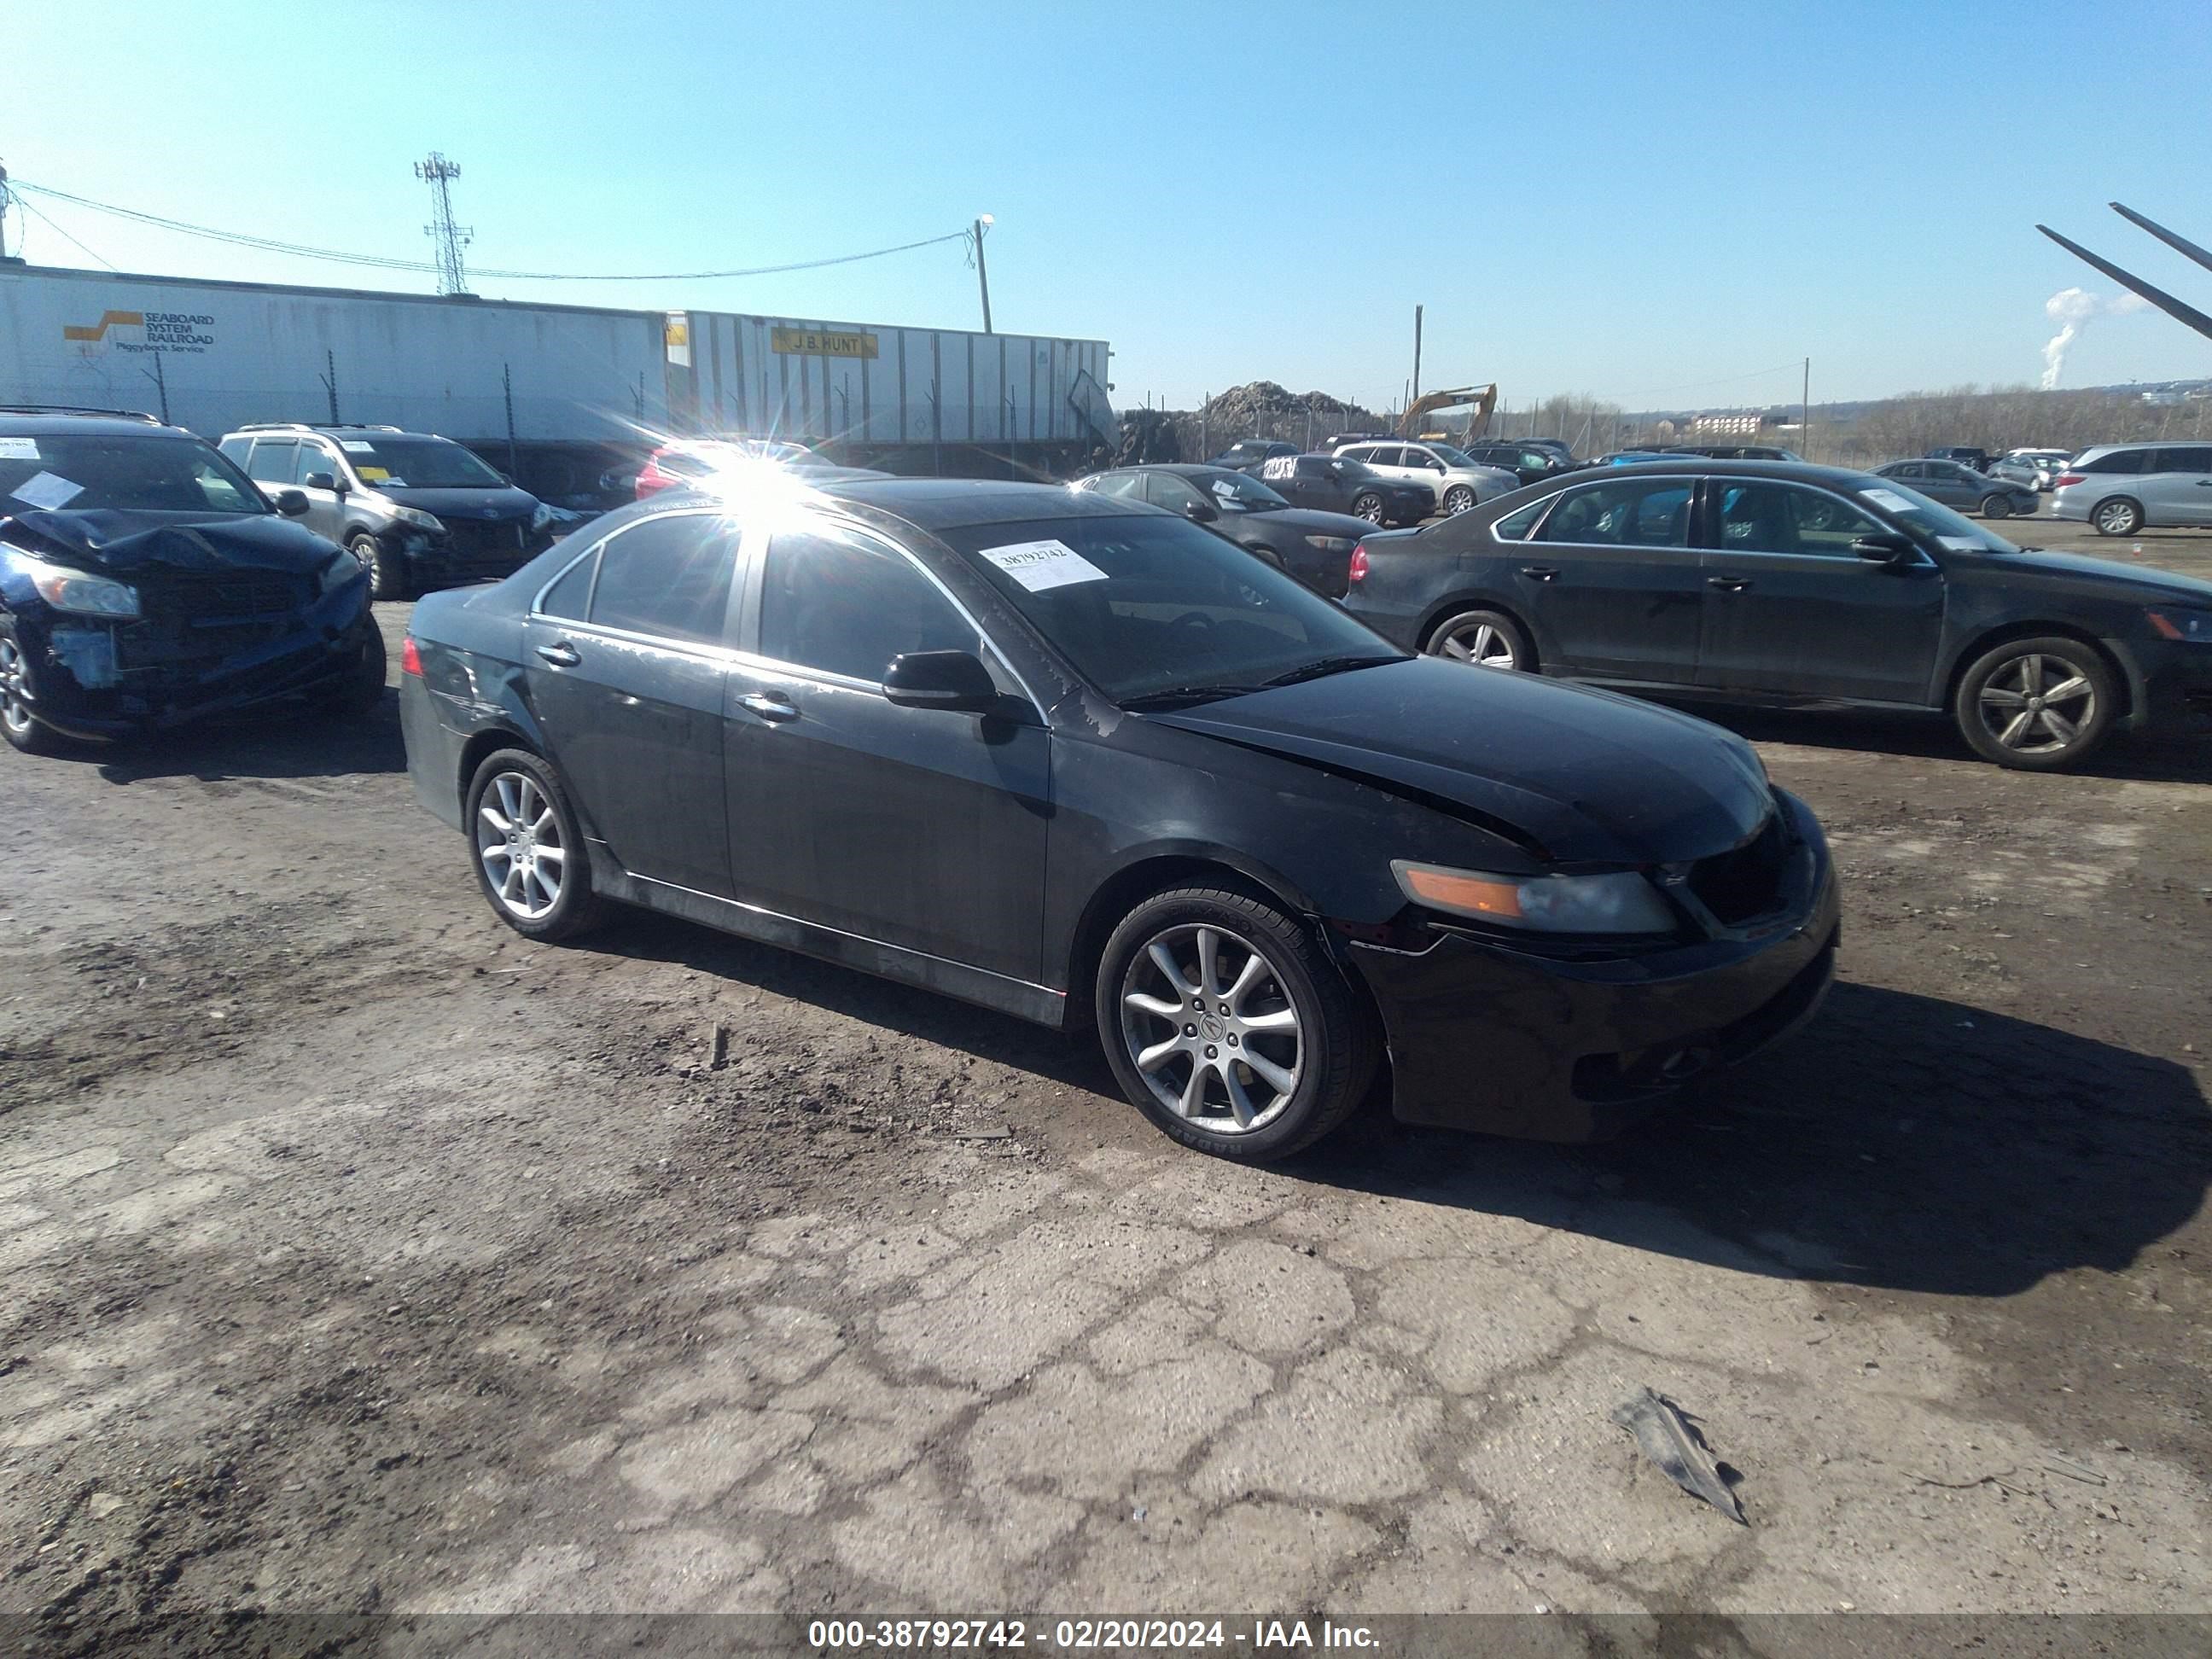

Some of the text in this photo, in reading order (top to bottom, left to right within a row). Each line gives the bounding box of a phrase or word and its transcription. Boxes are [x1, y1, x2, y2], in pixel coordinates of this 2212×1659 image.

[145, 312, 214, 325] SEABOARD
[147, 323, 192, 334] SYSTEM
[148, 333, 213, 345] RAILROAD
[822, 335, 859, 352] HUNT
[116, 342, 205, 353] Piggyback Service
[1001, 549, 1067, 566] 38792742
